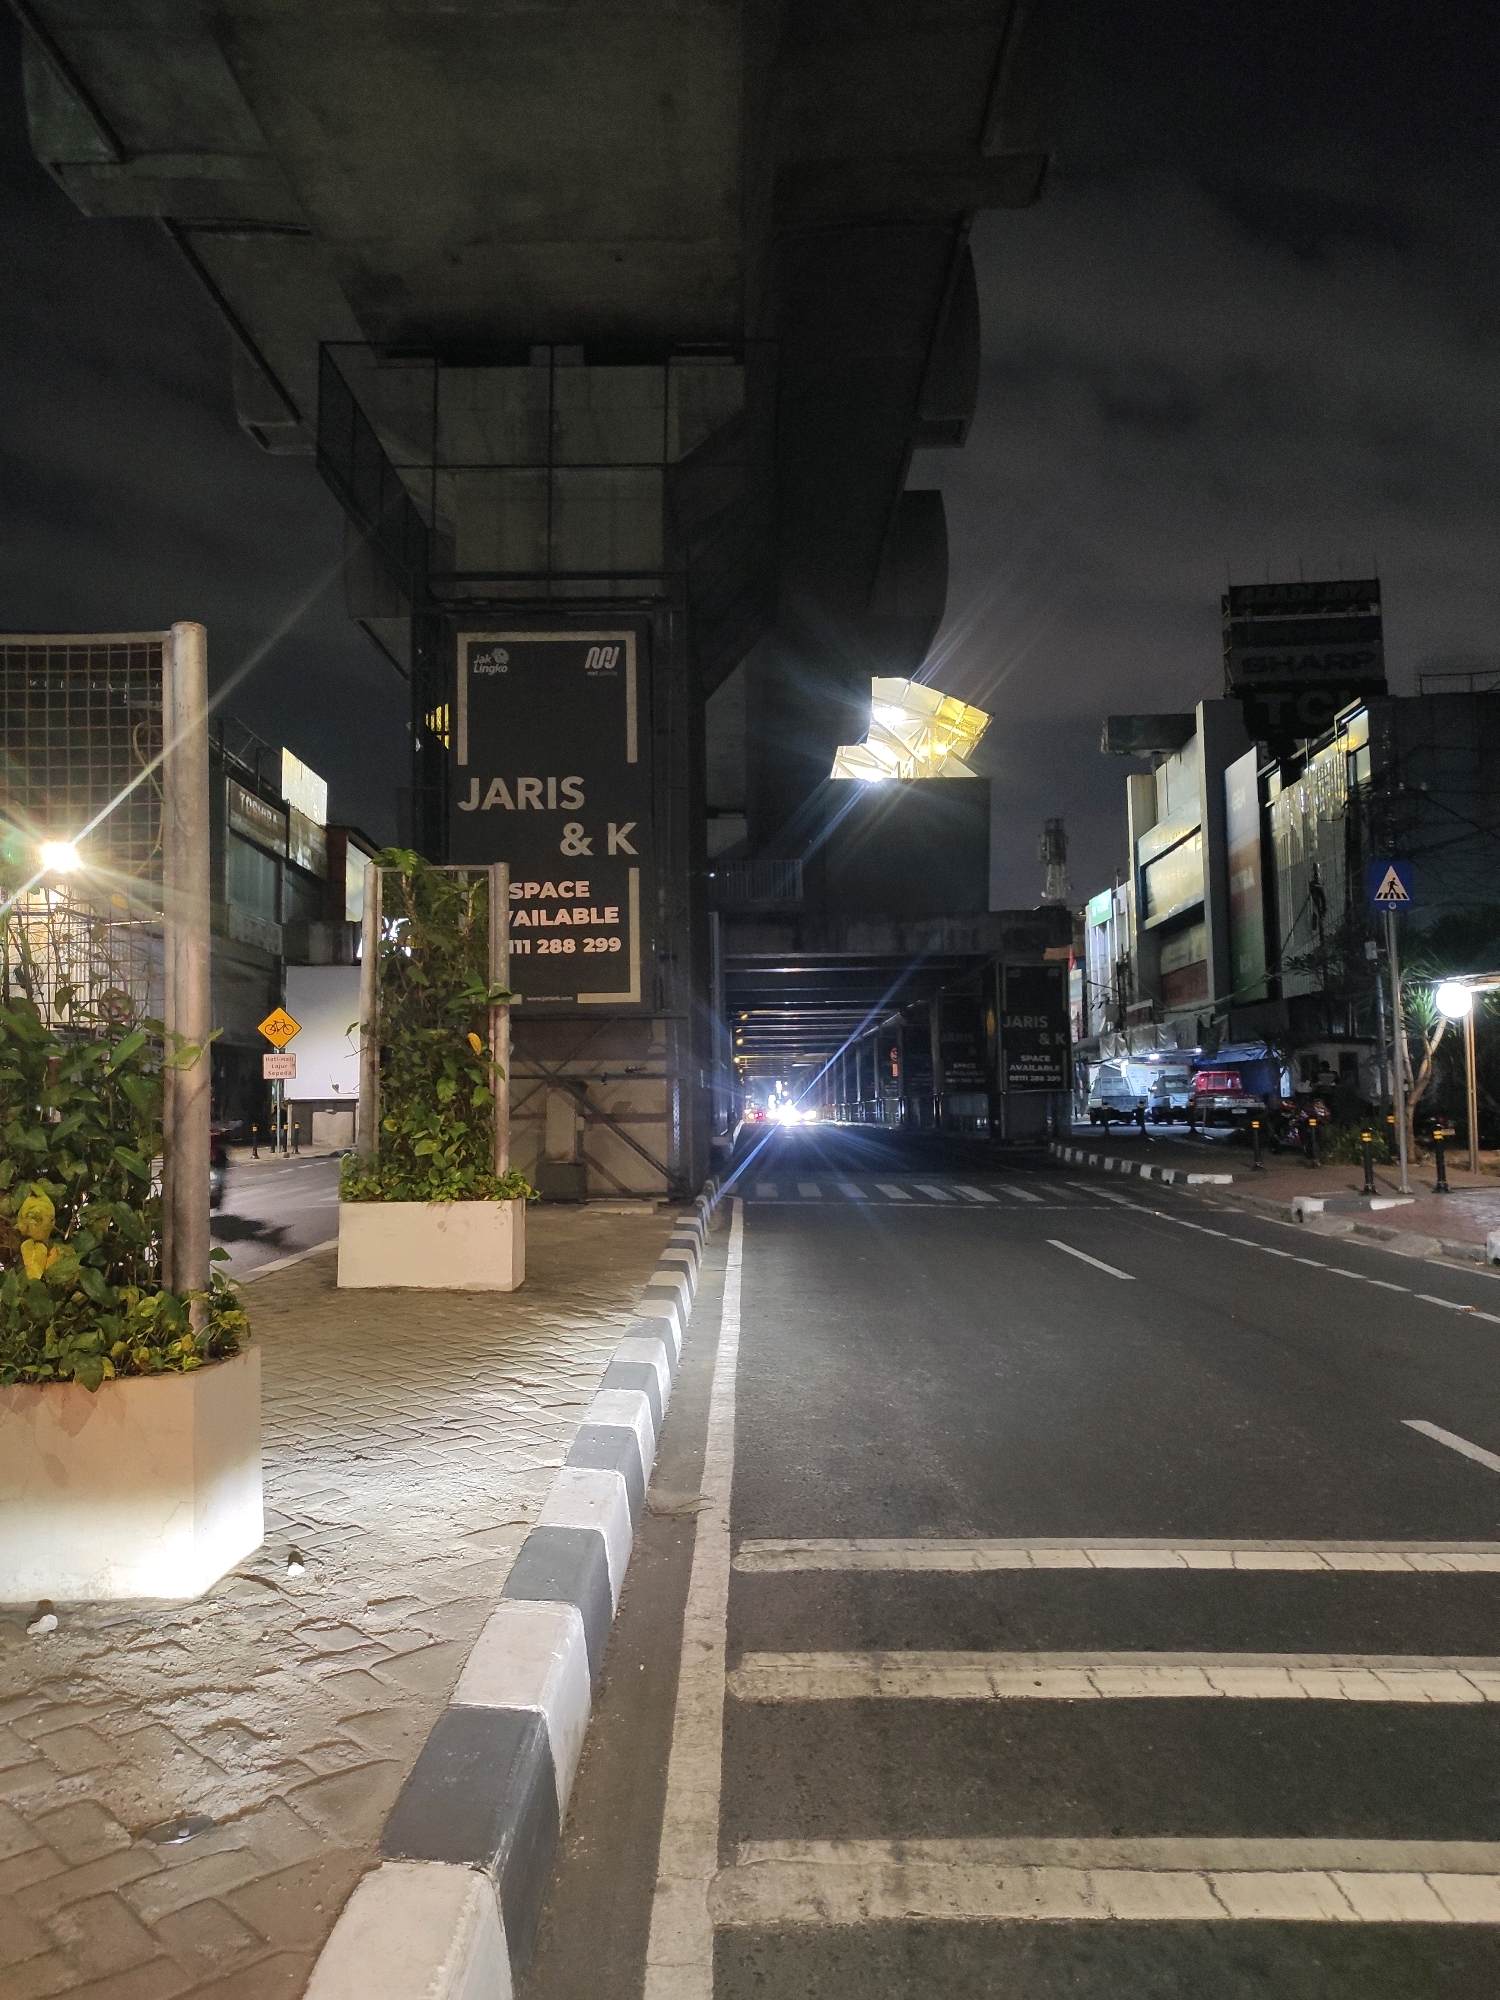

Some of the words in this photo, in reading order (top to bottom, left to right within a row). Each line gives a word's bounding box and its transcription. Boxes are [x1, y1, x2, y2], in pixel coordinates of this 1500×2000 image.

[473, 654, 491, 664] Jak
[1242, 651, 1376, 673] SHARP
[473, 663, 508, 675] Lingko
[457, 775, 585, 811] JARIS
[560, 822, 594, 856] &
[608, 822, 638, 855] K
[509, 880, 590, 900] SPACE
[508, 906, 620, 927] AILABLE
[509, 939, 531, 954] 111
[536, 938, 576, 954] 288
[582, 937, 622, 953] 299
[1003, 1015, 1049, 1029] JARIS
[1038, 1032, 1050, 1045] &
[1055, 1032, 1066, 1045] K
[1020, 1054, 1051, 1062] SPACE
[1009, 1064, 1061, 1072] AVAILABLE
